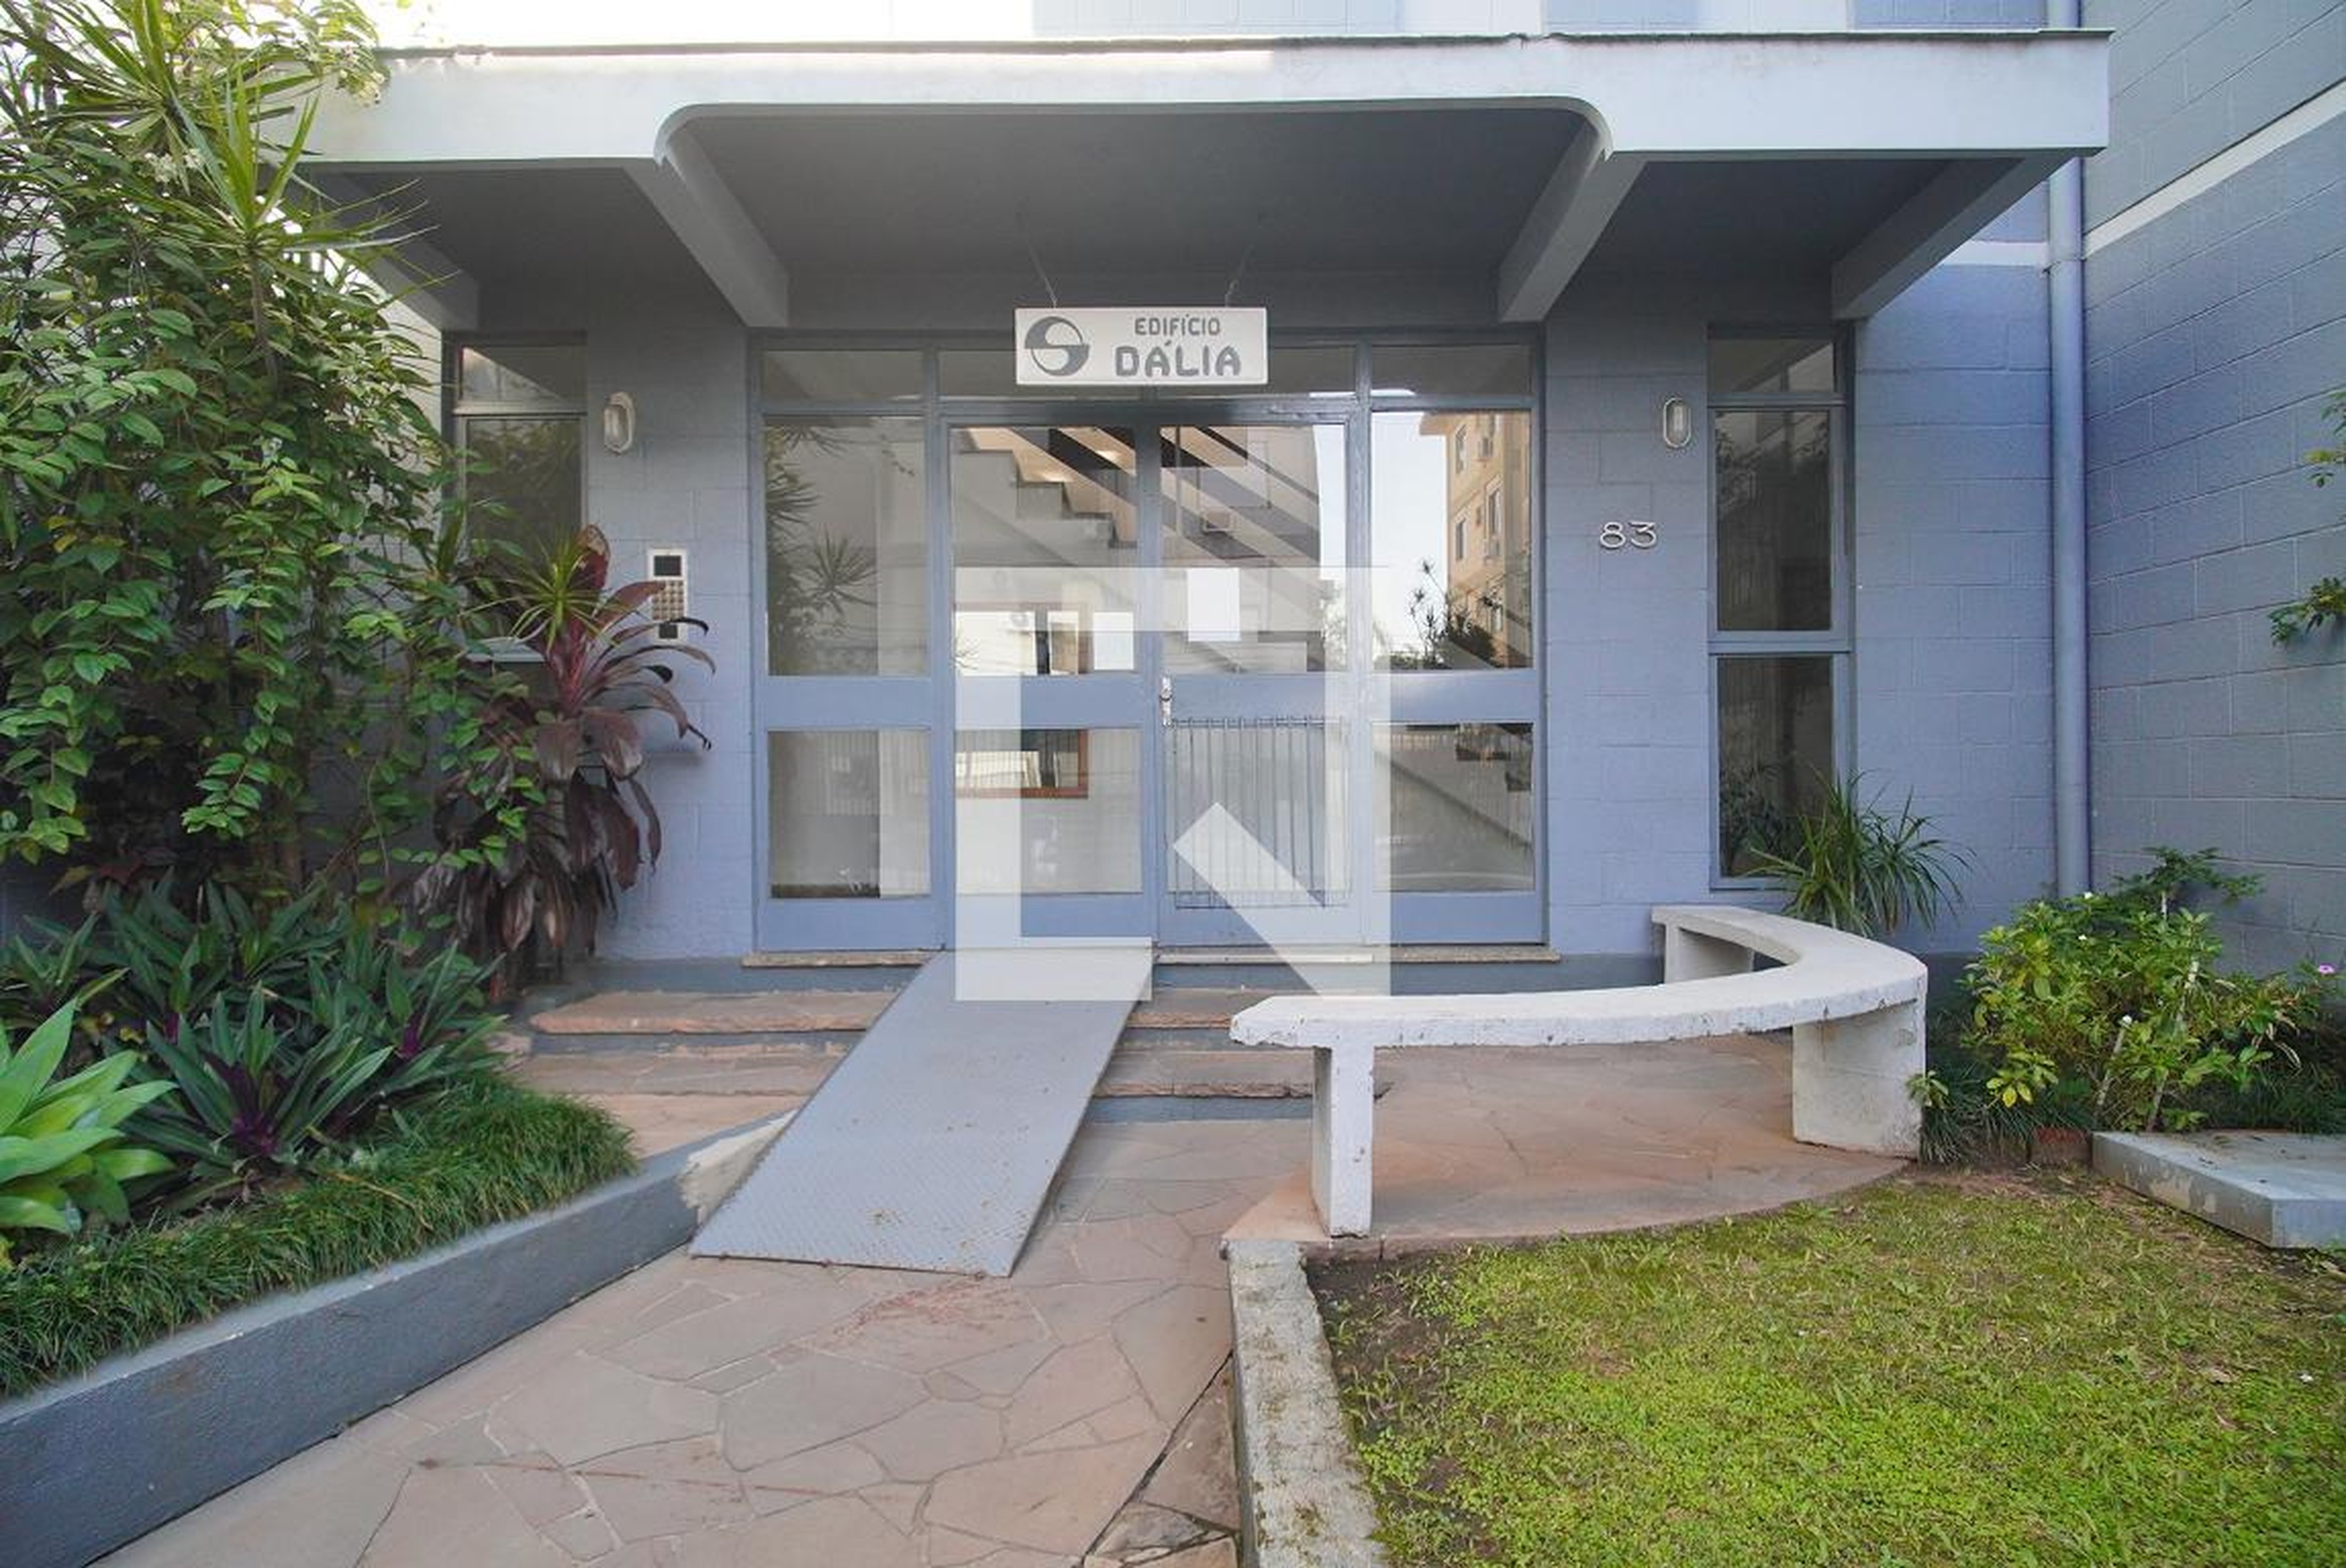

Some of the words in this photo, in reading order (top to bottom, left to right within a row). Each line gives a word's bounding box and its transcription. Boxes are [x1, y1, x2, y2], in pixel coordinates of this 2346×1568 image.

[1135, 314, 1221, 336] EDIFÍCIO
[1115, 340, 1241, 376] DÁLIA
[1599, 521, 1656, 549] 83
